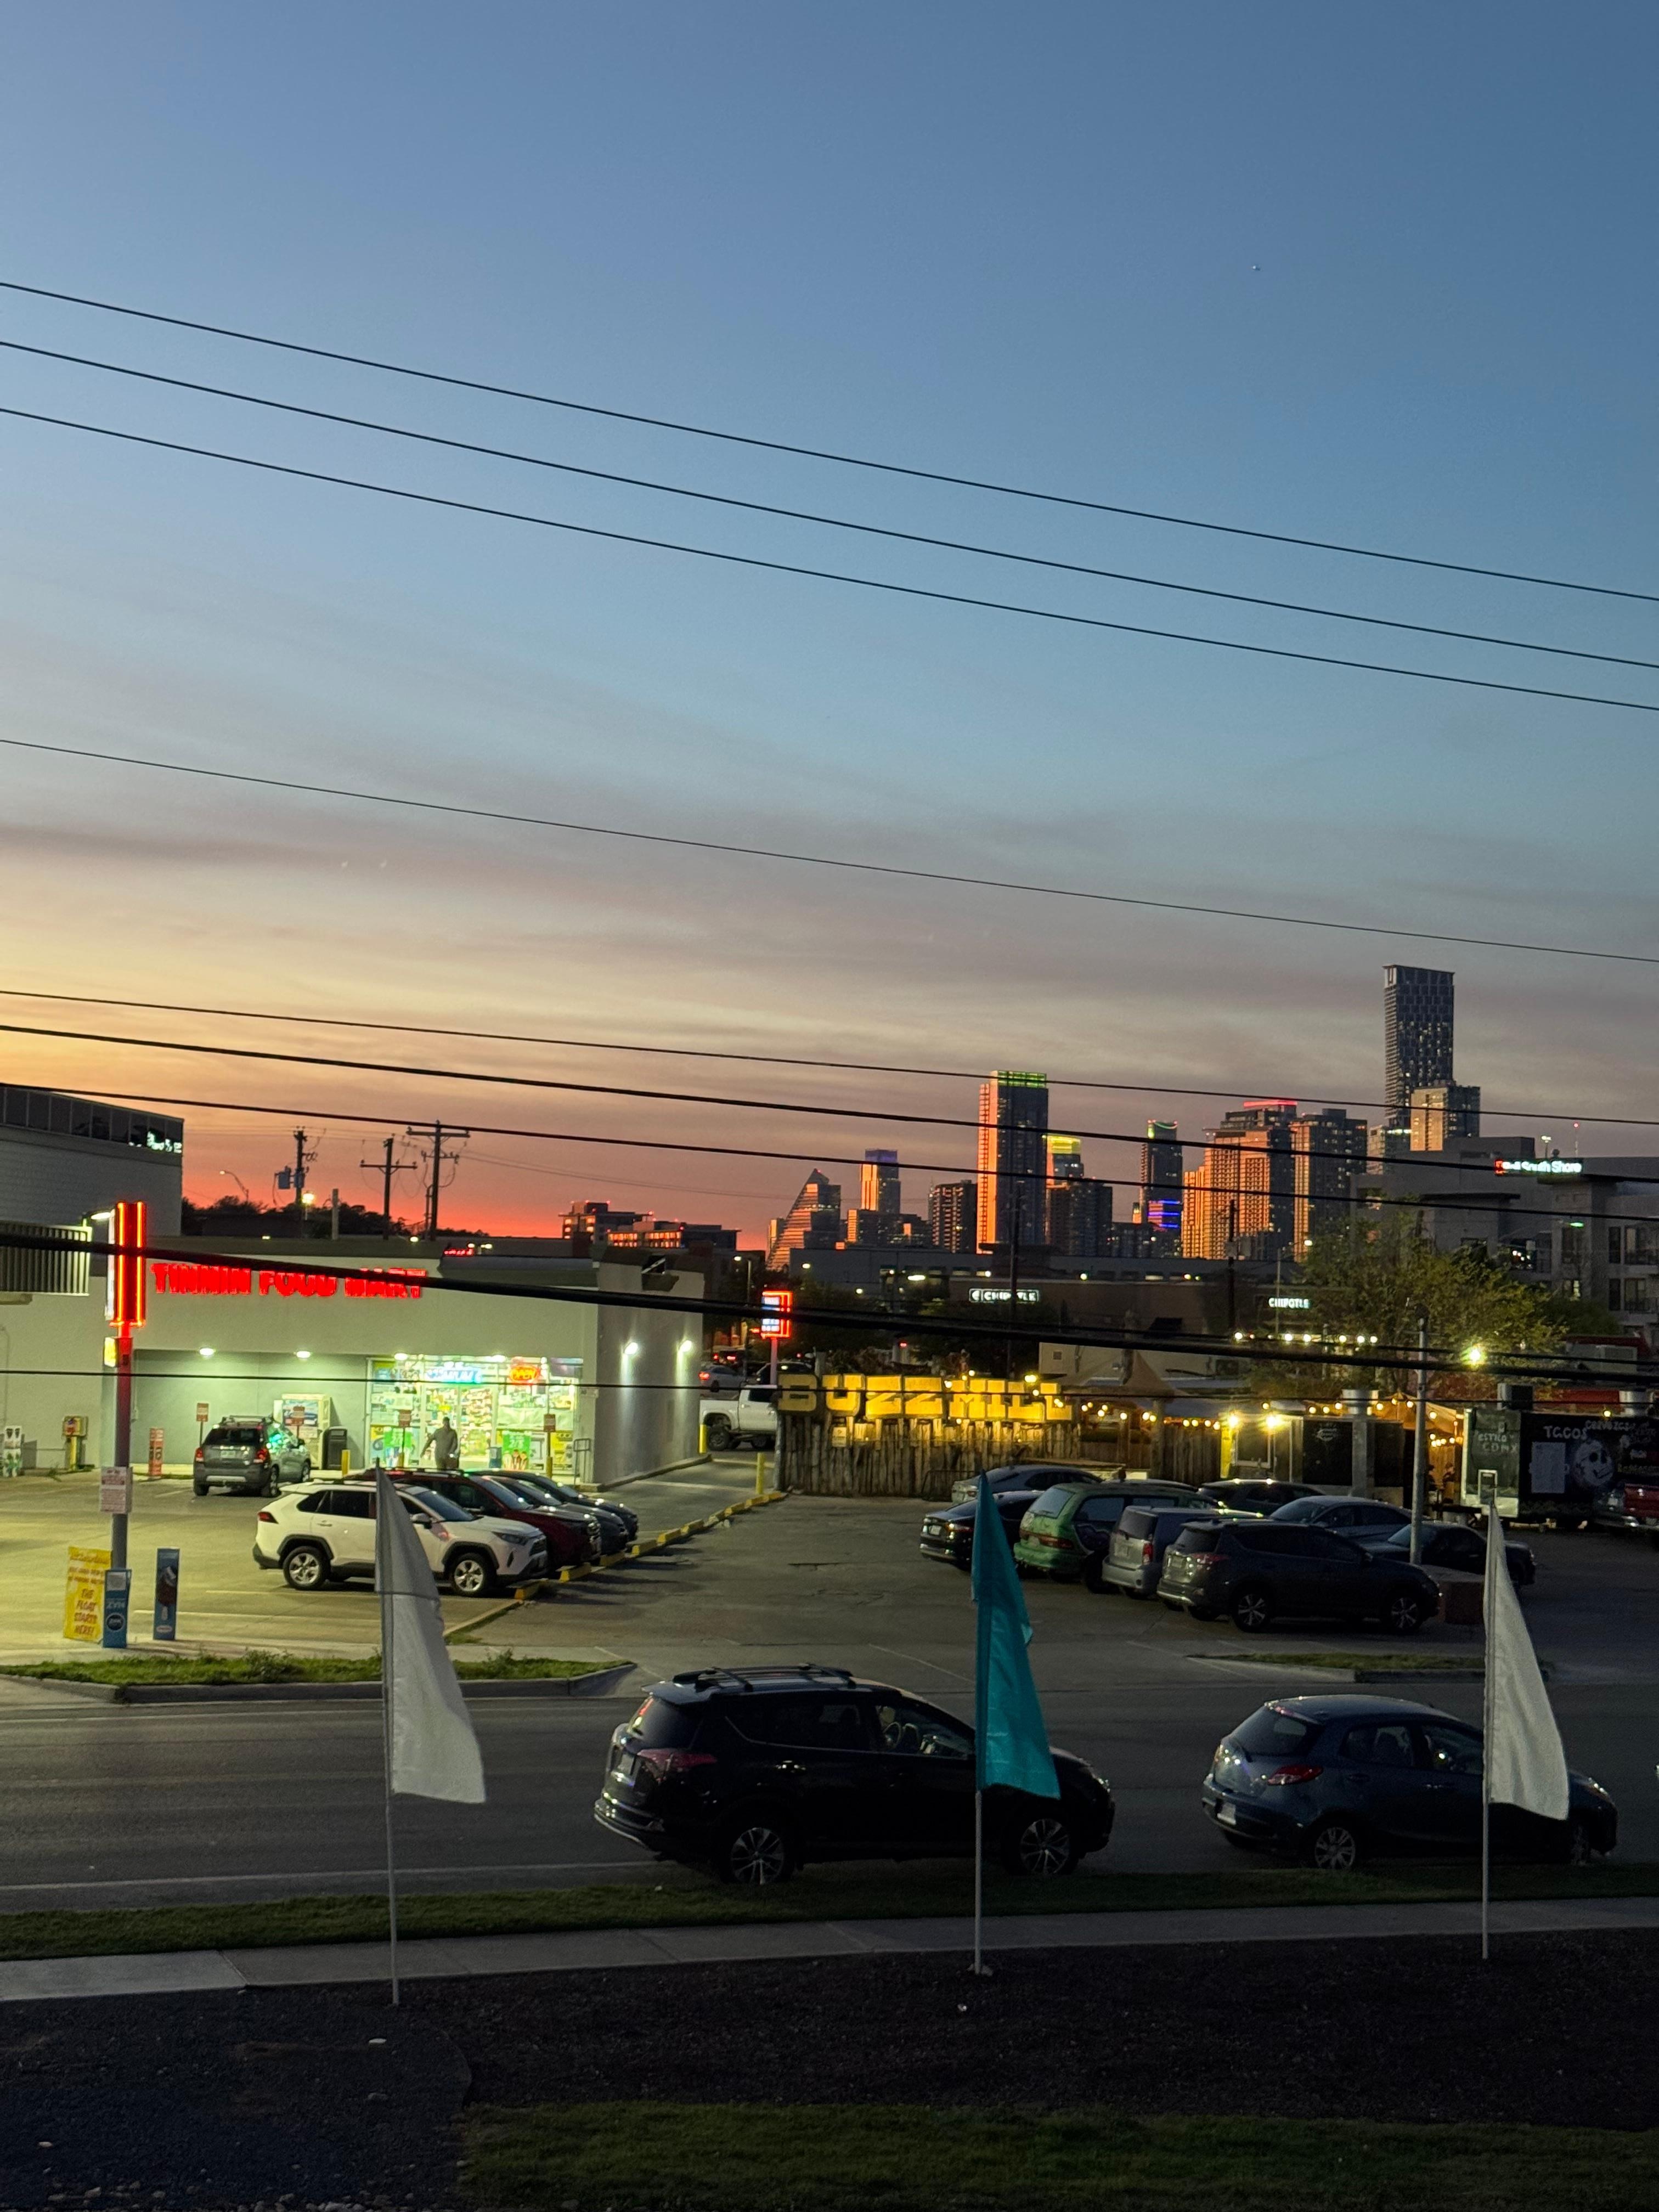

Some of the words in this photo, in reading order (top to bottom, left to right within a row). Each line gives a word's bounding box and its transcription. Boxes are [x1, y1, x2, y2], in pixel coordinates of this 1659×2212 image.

[1551, 1160, 1582, 1173] Shore
[259, 1269, 338, 1298] FOOD
[984, 1291, 1036, 1301] CHIPTLE
[1268, 1297, 1310, 1309] CHIPOTLE
[511, 1367, 537, 1380] OPEN
[777, 1373, 943, 1420] BUZZ
[949, 1378, 1073, 1421] MILL
[1543, 1425, 1588, 1441] TACOS
[1482, 1441, 1517, 1453] CDMX
